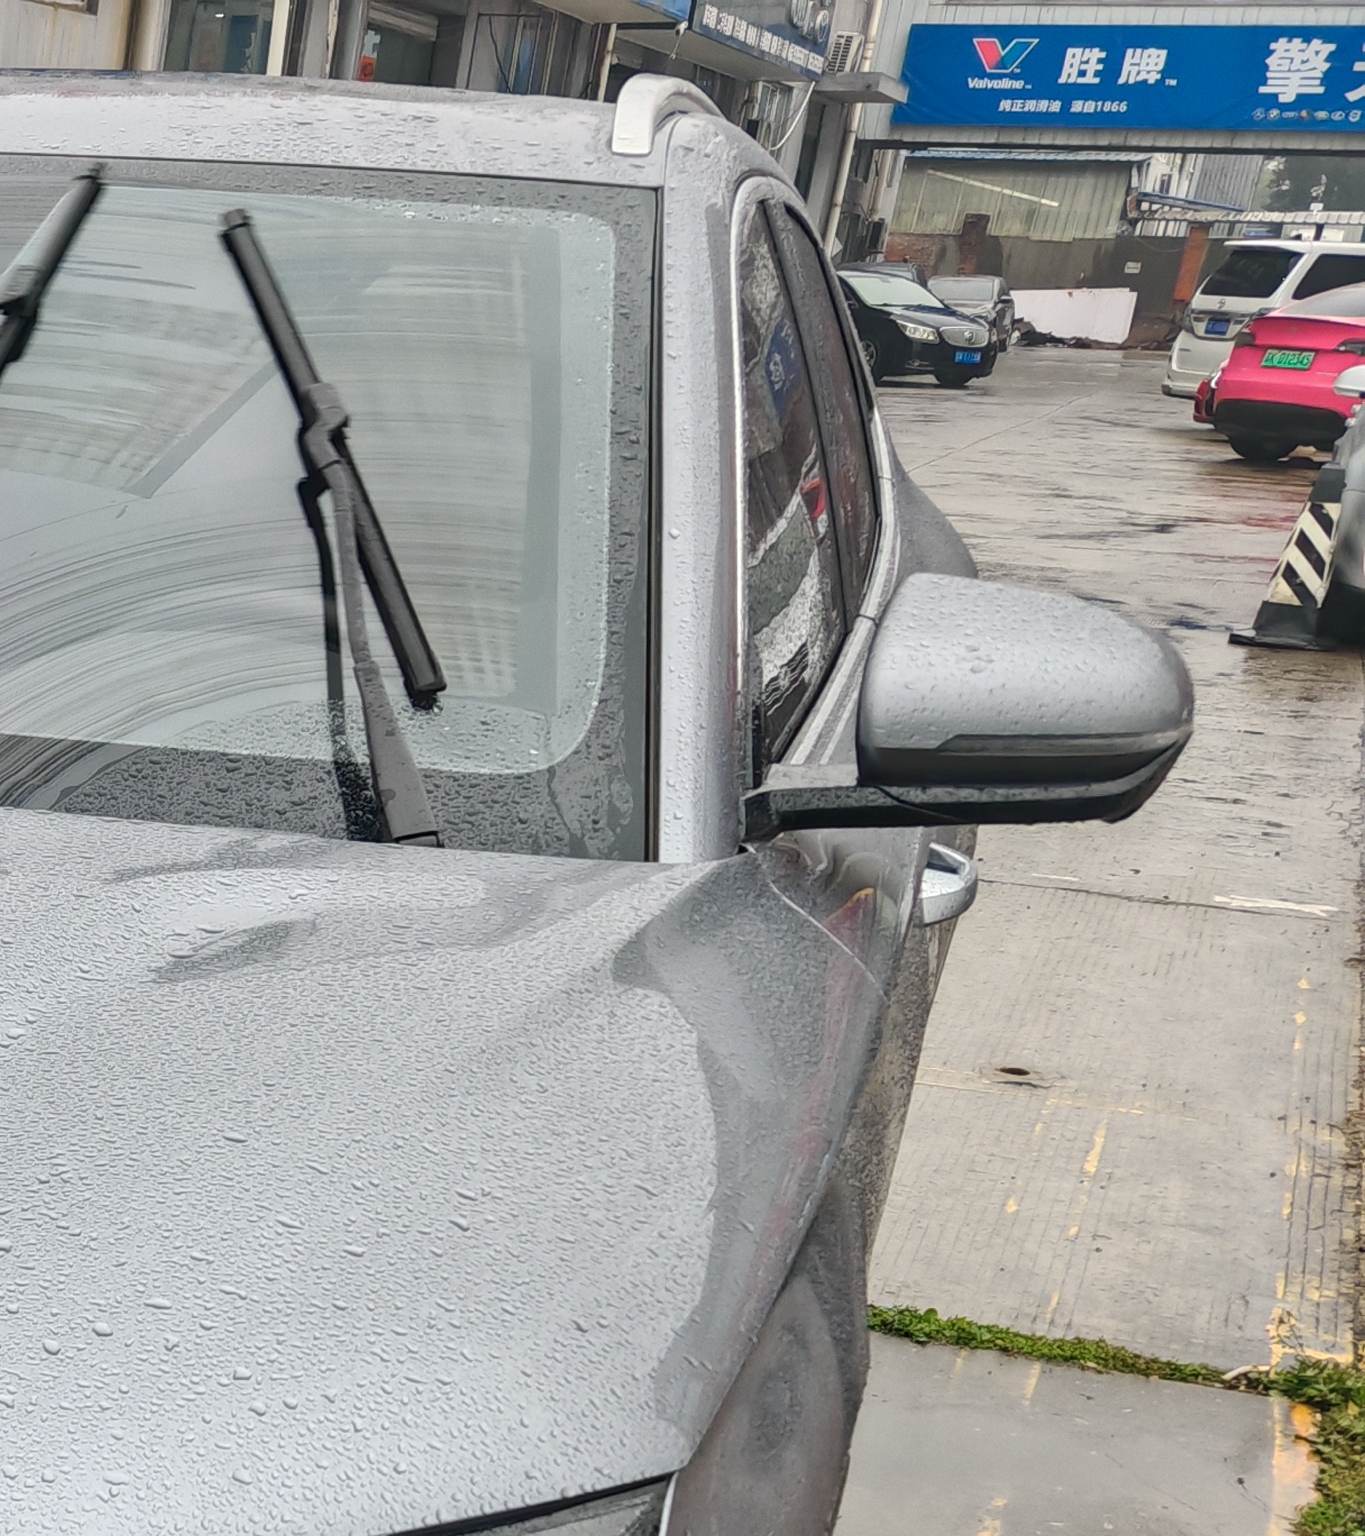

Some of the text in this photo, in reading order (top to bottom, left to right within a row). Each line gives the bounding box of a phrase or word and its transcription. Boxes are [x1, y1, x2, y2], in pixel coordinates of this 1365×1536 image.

[1057, 48, 1167, 84] 胜牌
[968, 78, 1024, 89] Valvoline
[1070, 100, 1127, 113] 源自1866
